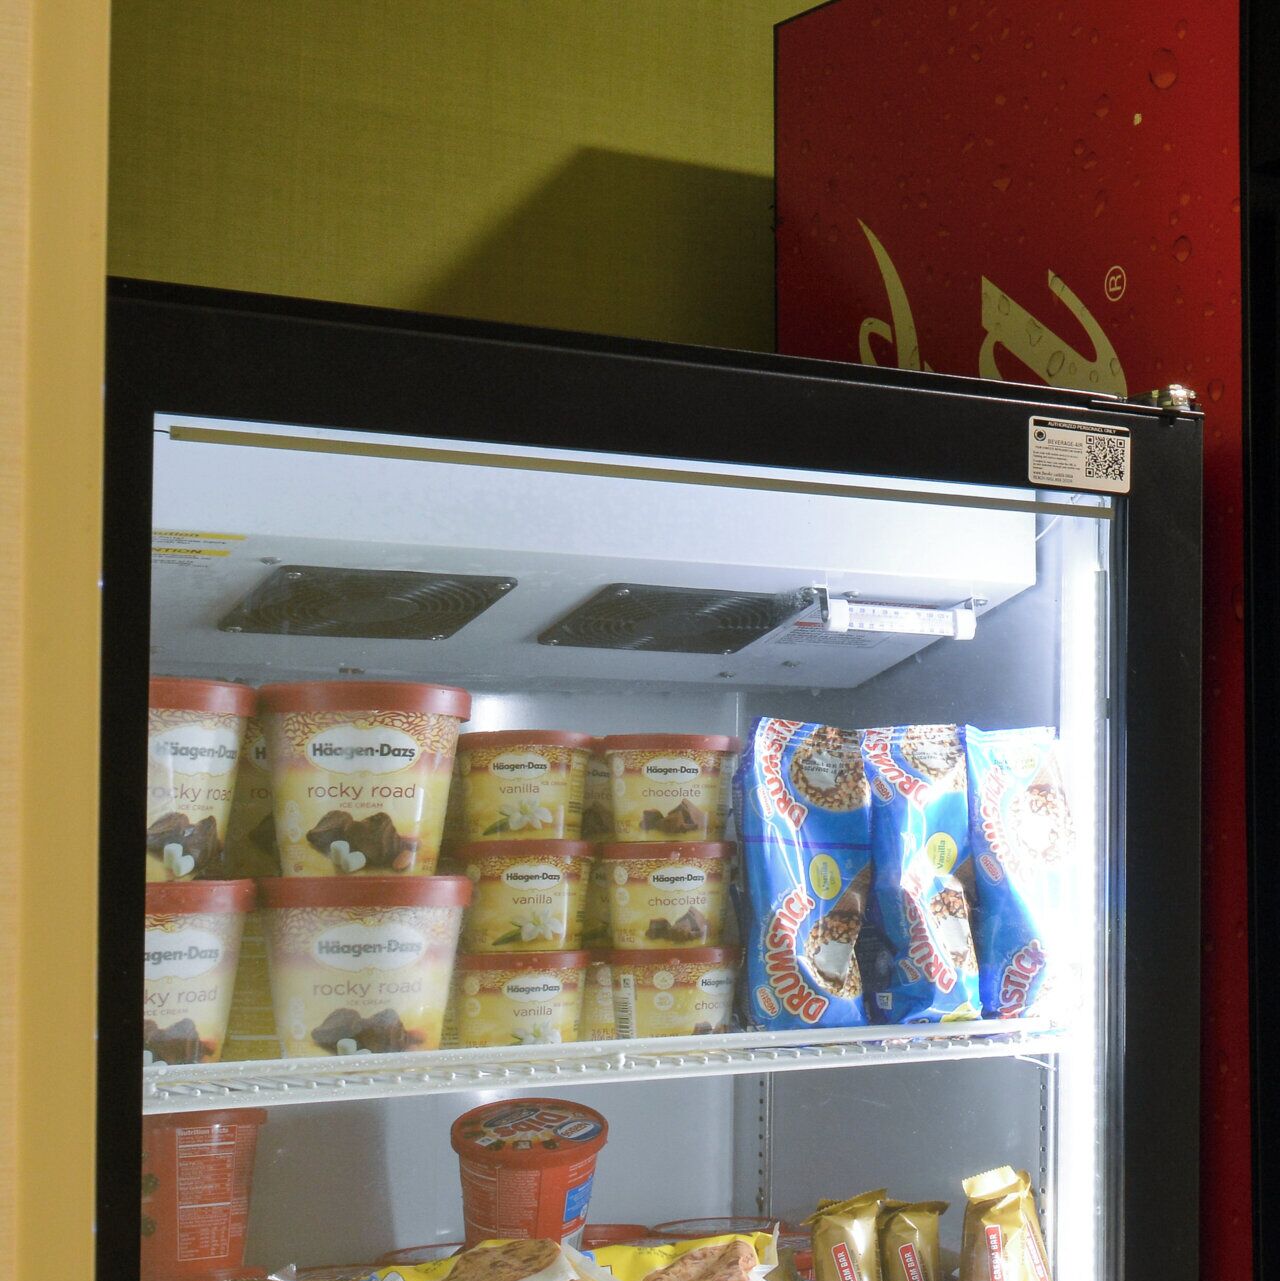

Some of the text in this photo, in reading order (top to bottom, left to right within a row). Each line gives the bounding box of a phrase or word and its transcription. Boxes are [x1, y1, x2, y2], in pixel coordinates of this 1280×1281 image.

[307, 781, 416, 801] rocky road
[499, 782, 541, 795] vanilla
[641, 786, 701, 798] chocolate
[512, 893, 553, 906] vanilla
[647, 895, 707, 907] chocolate
[766, 883, 829, 1025] DRUMSTICK
[178, 985, 217, 1005] road
[312, 977, 423, 1000] rocky road
[513, 1005, 553, 1017] vanilla
[838, 1250, 848, 1268] BAR
[904, 1251, 913, 1269] BAR
